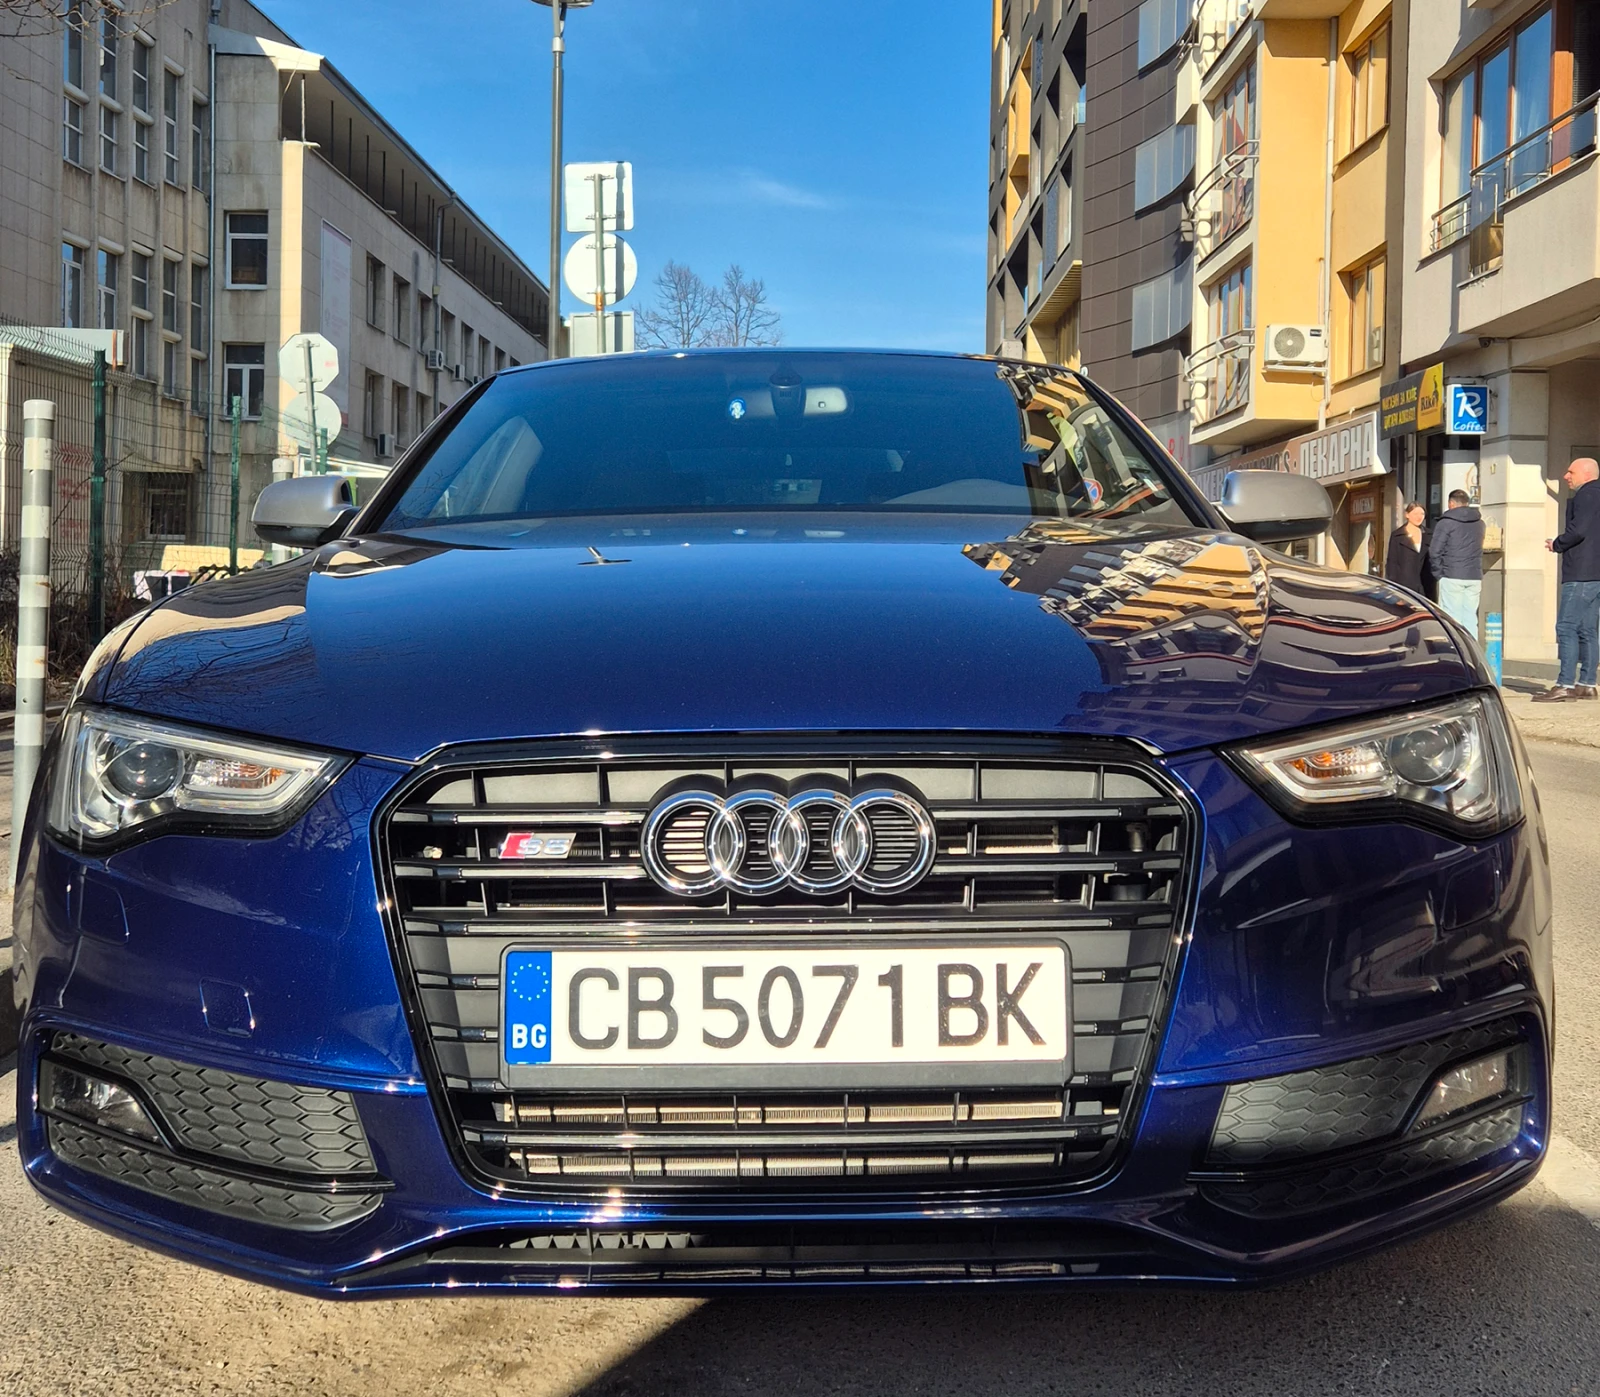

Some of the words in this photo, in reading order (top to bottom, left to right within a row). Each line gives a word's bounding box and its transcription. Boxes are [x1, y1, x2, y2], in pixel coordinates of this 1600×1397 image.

[1454, 421, 1486, 431] Coffee
[1300, 421, 1373, 479] ПЕКАРНА
[702, 963, 904, 1049] 5071
[937, 962, 1047, 1047] BK
[511, 1023, 547, 1049] BG
